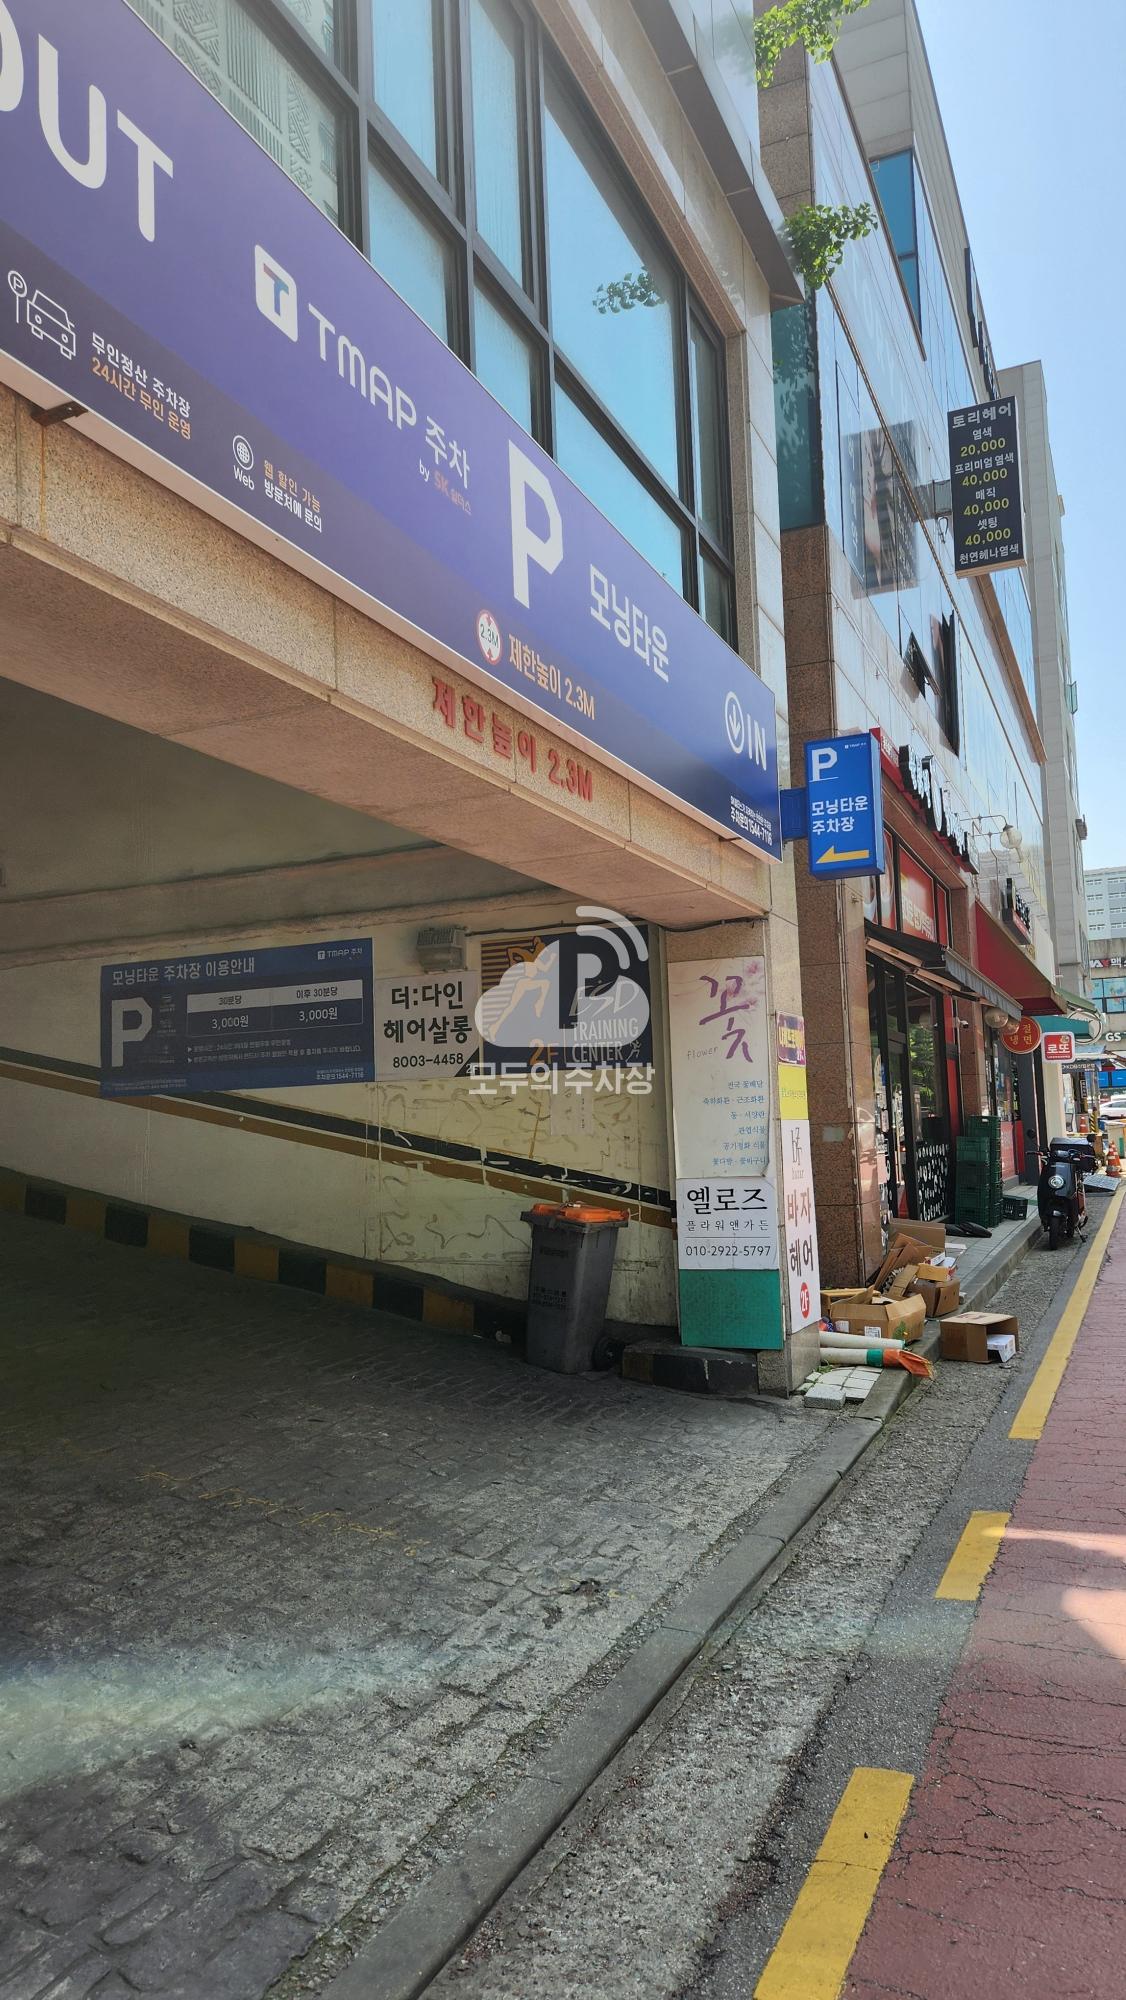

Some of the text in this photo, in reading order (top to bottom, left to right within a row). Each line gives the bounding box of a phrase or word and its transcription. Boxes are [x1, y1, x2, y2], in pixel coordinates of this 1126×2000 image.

[92, 332, 191, 418] 무인정산 주차장
[91, 357, 191, 440] 24시간 무인 운영
[308, 303, 470, 489] TMAP 주차
[952, 402, 1012, 429] 토리헤어
[972, 426, 992, 441] 염색
[960, 437, 1006, 457] 20,000
[233, 465, 255, 490] Web
[419, 459, 430, 482] by
[962, 467, 1008, 487] 40,000
[278, 470, 298, 497] 할인
[302, 488, 321, 513] 가능
[975, 487, 996, 501] 매직
[264, 478, 322, 533] 방문처에 문의
[963, 498, 1009, 516] 40,000
[508, 439, 563, 609] P
[977, 517, 998, 531] 셋팅
[965, 528, 1011, 547] 40,000
[590, 563, 670, 683] 모닝타운
[480, 624, 499, 648] 2.3M
[508, 633, 595, 720] 제한높이 2.3M
[747, 713, 767, 772] IN
[547, 748, 593, 802] 2.3M
[811, 795, 868, 817] 모닝타운
[811, 817, 855, 836] 주차장
[328, 949, 350, 958] TMAP
[112, 956, 255, 986] 모닝타운 주차장 이용안내
[296, 989, 311, 999] 이후
[313, 986, 338, 997] 30분당
[391, 981, 463, 1010] 더:다인
[211, 1006, 338, 1031] 3,000원 3,000원
[383, 1015, 472, 1045] 헤어살롱
[571, 1017, 639, 1041] TRAINING
[699, 975, 753, 1063] 꽃
[393, 1052, 464, 1068] 8003-4458
[572, 1041, 624, 1062] CENTER
[687, 1186, 767, 1214] 옐로즈
[787, 1187, 811, 1227] 바자
[685, 1245, 771, 1256] 010-2922-5797
[789, 1235, 814, 1277] 헤어
[800, 1290, 809, 1312] 2F
